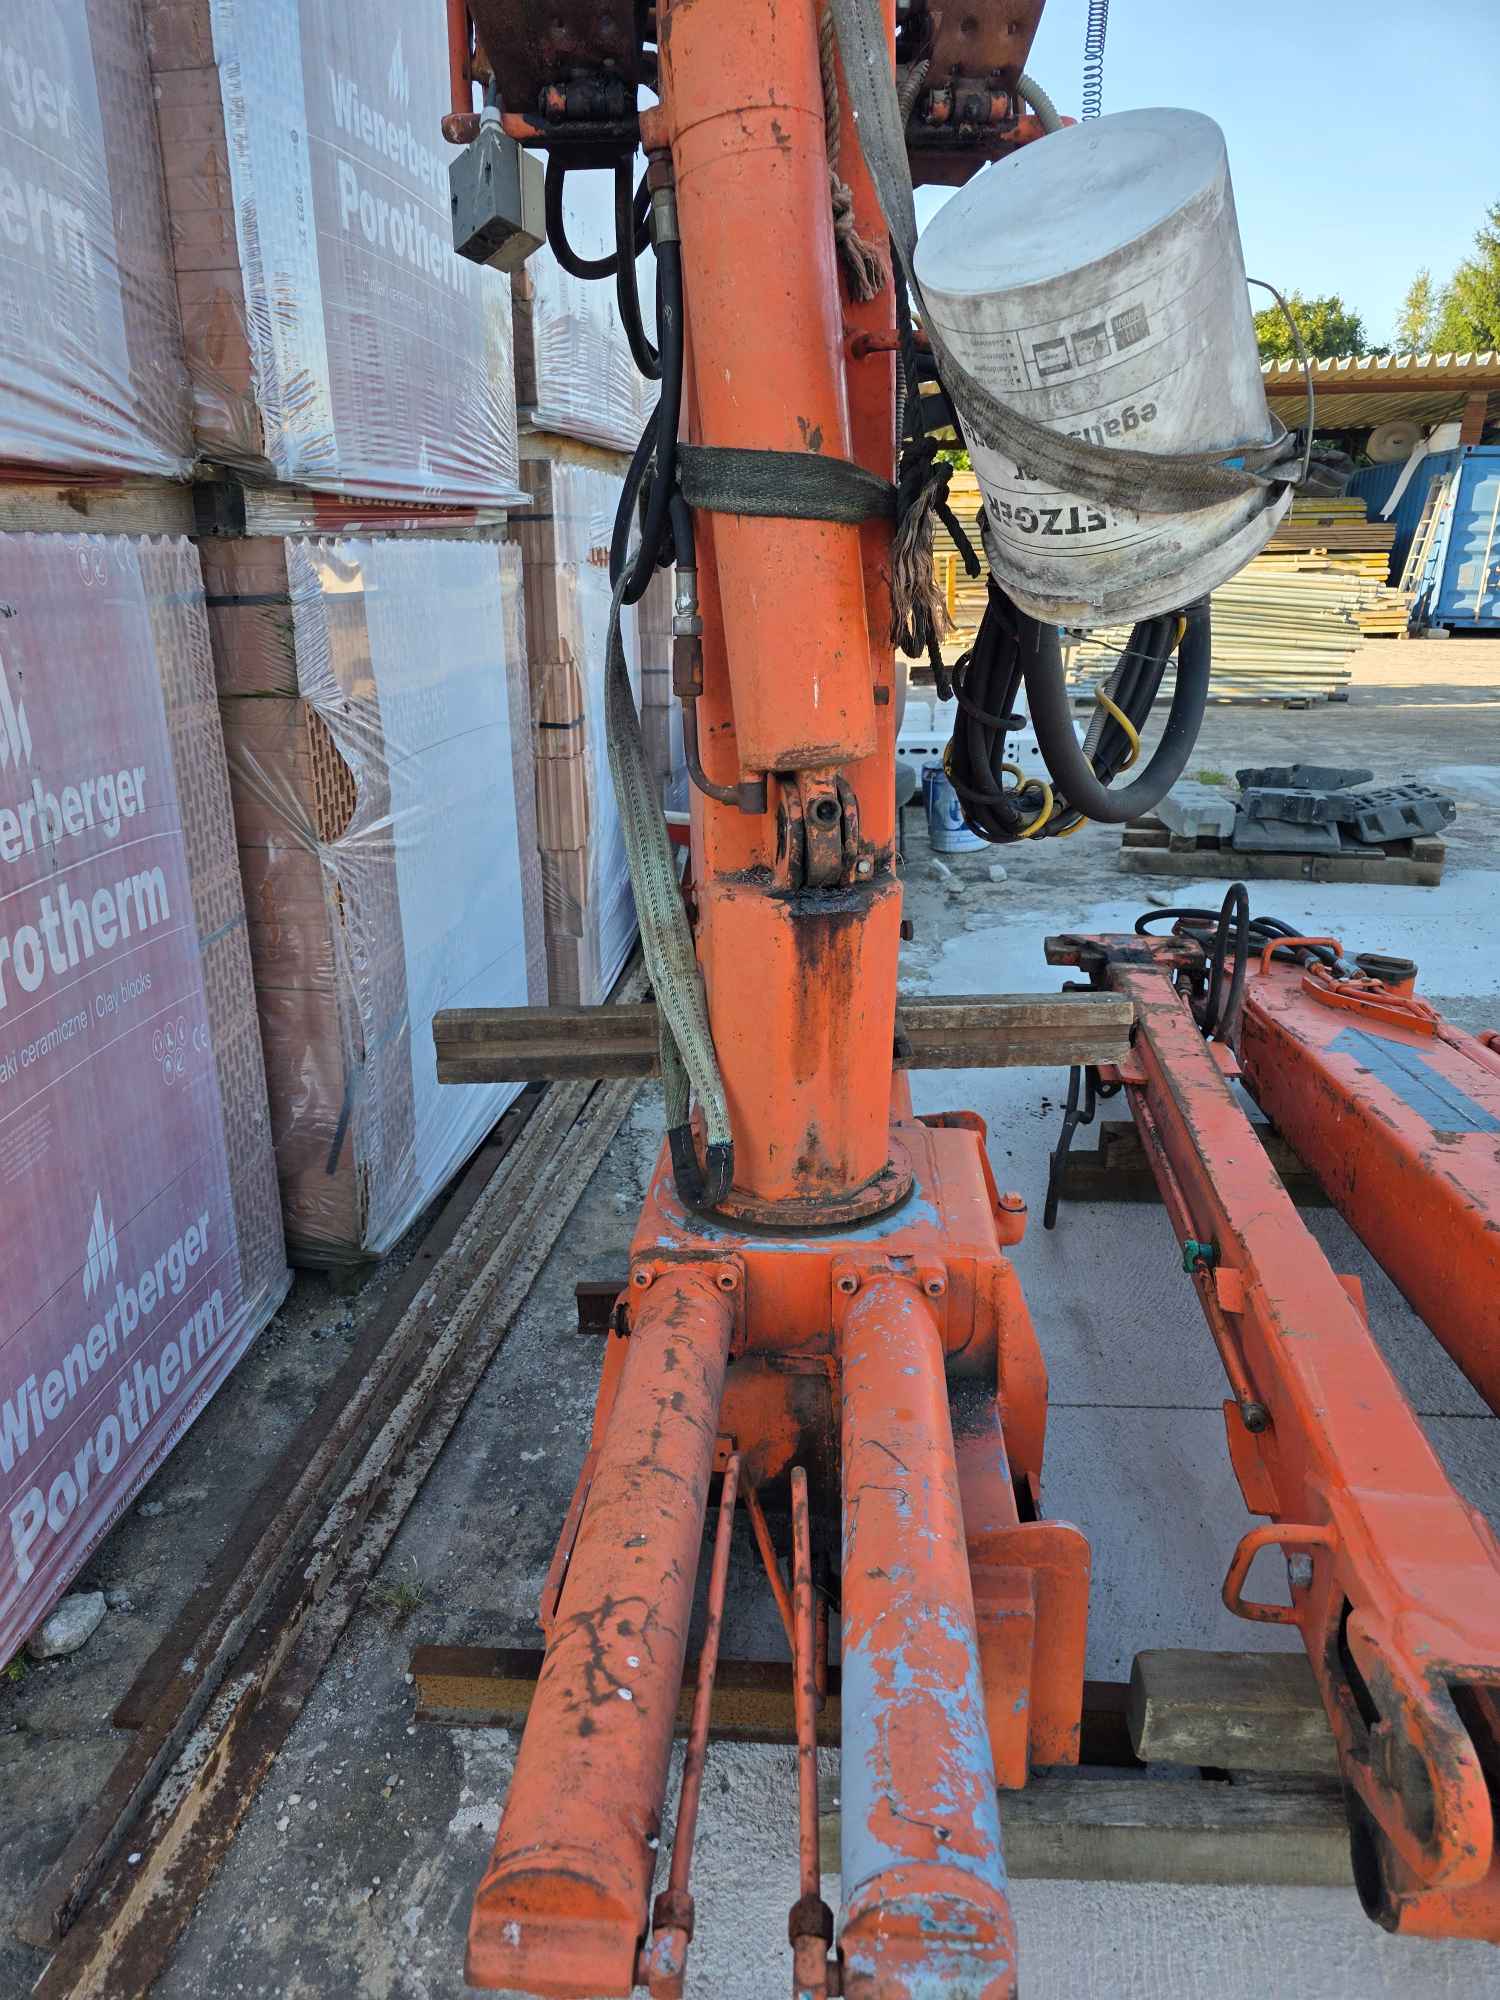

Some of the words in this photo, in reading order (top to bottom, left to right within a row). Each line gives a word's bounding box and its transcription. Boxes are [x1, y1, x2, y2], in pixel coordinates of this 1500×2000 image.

[328, 66, 450, 209] Wienerberg
[987, 494, 1110, 536] ETZGER
[20, 1009, 88, 1068] ceramiczne
[95, 992, 119, 1017] Clay
[120, 972, 152, 1002] blocks
[0, 1210, 209, 1473] Wienerberger
[9, 1289, 225, 1584] Porotherm
